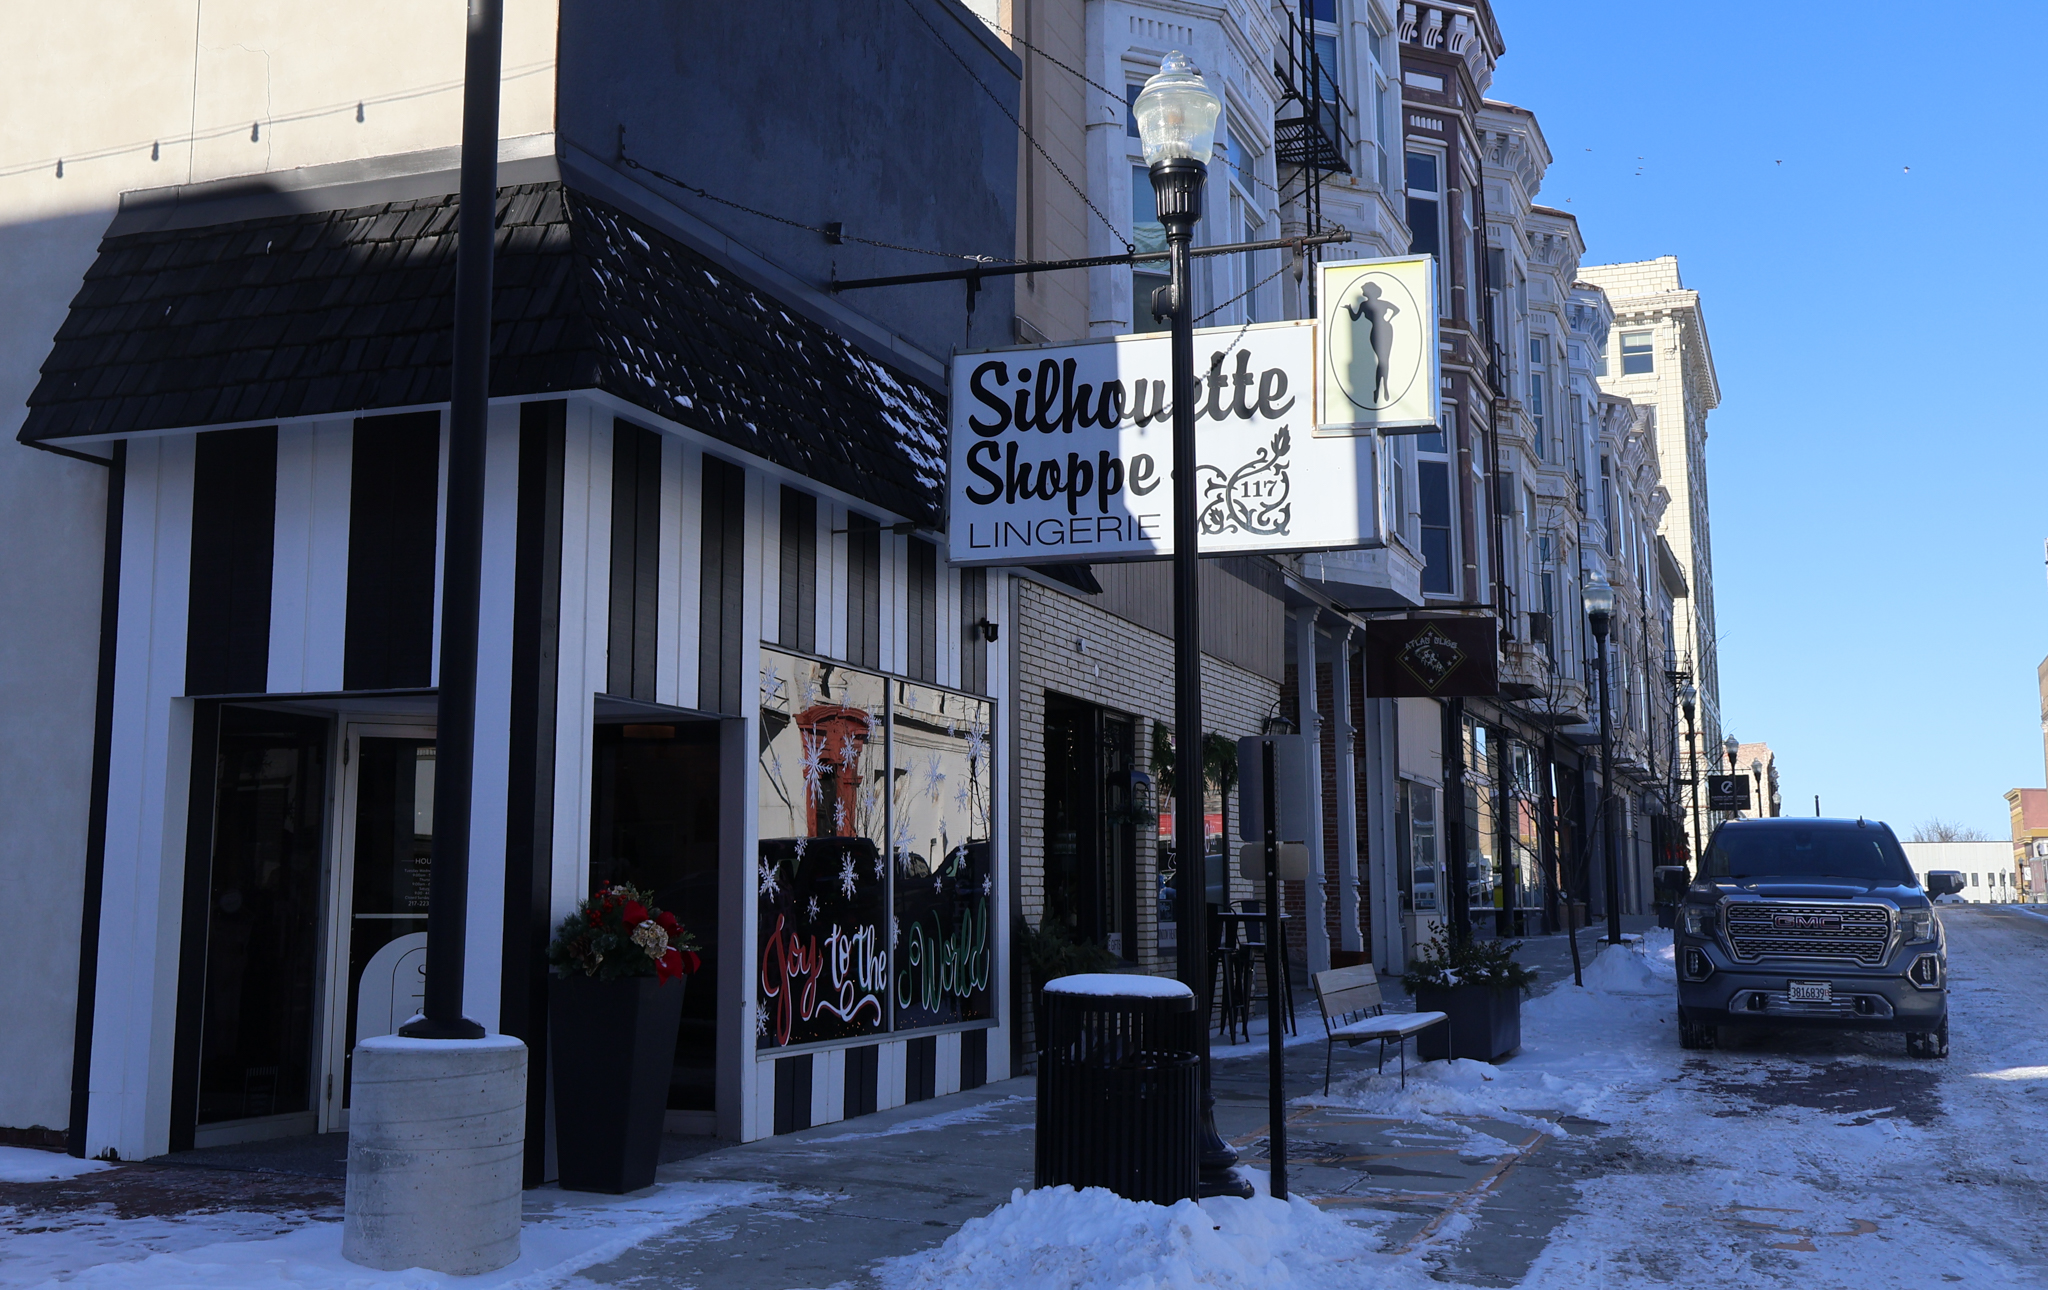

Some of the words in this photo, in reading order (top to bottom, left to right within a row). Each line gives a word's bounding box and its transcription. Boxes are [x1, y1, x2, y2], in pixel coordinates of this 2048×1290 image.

[968, 348, 1295, 438] Silhoutte
[965, 440, 1160, 516] Shoppe
[1241, 480, 1278, 498] 117
[969, 513, 1161, 549] LINGERIE
[1775, 915, 1840, 929] GMC
[762, 913, 823, 1047] Joy
[825, 923, 851, 992] to
[853, 923, 887, 993] the
[898, 897, 990, 1013] World
